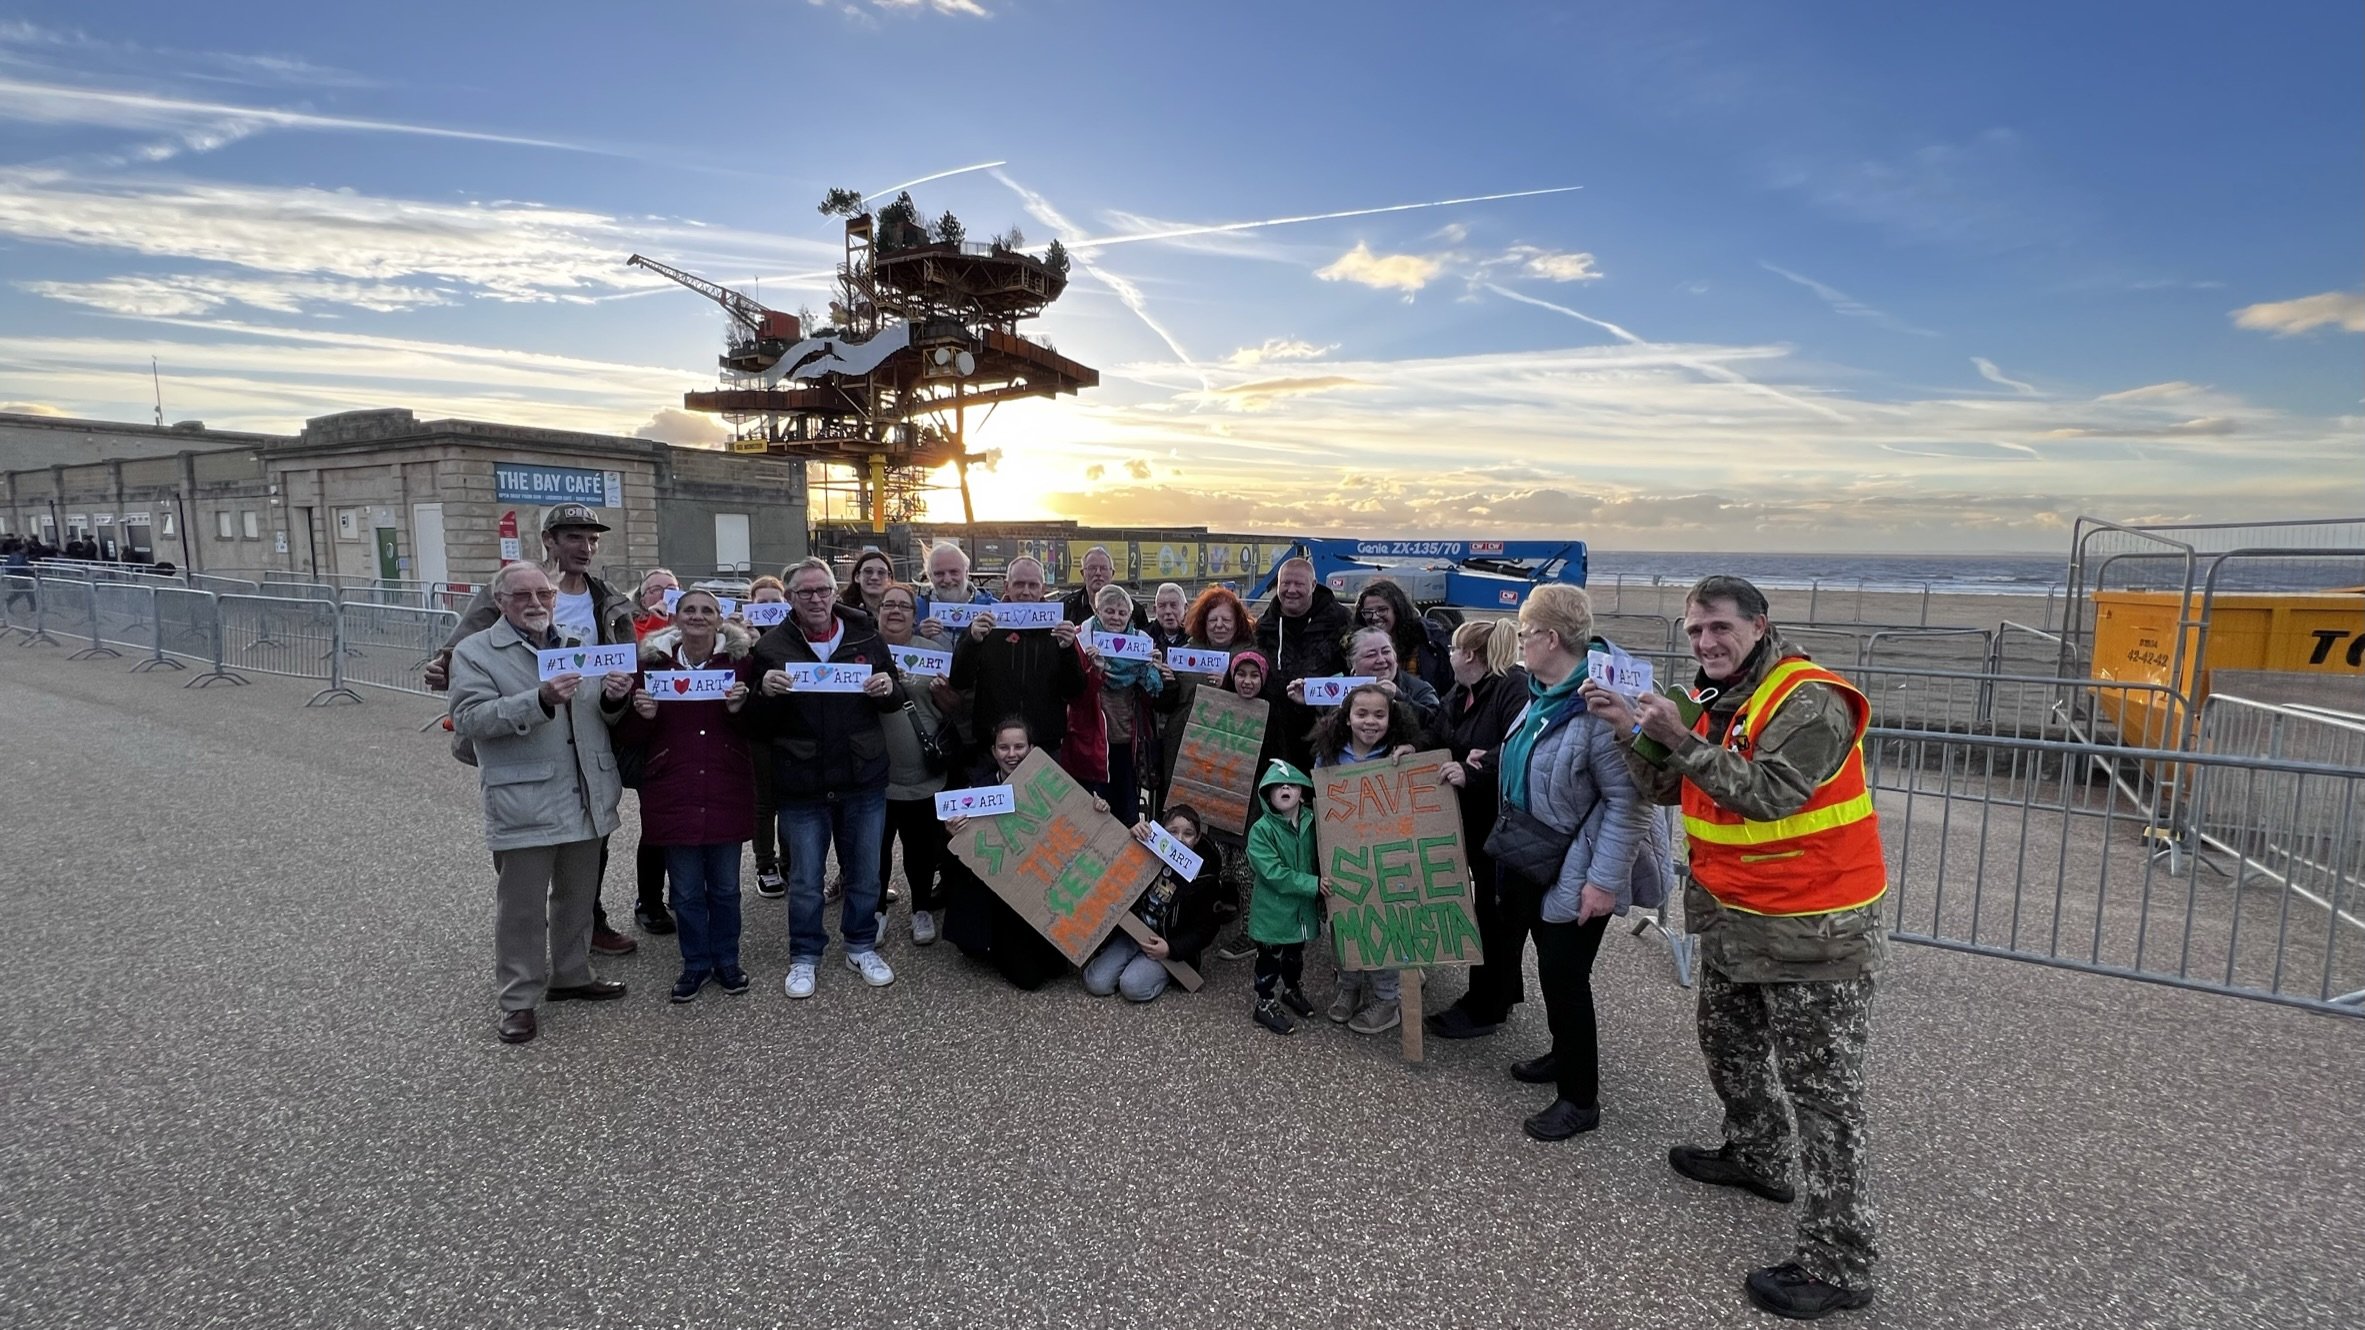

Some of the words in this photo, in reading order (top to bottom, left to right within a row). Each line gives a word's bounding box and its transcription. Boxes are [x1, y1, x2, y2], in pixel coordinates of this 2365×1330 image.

[497, 471, 528, 490] THE
[533, 473, 561, 492] BAY
[565, 472, 602, 494] CAFÉ
[1357, 542, 1389, 554] Genie
[1391, 542, 1461, 555] ZX-135/70
[1031, 611, 1055, 622] ART
[1098, 638, 1110, 649] #I
[1126, 641, 1147, 653] ART
[546, 657, 566, 671] #I
[593, 653, 625, 666] ART
[918, 656, 943, 669] ART
[1171, 655, 1184, 664] #I
[1200, 657, 1221, 667] ART
[652, 680, 669, 693] #I
[695, 679, 725, 692] ART
[793, 671, 809, 683] #I
[833, 672, 861, 683] ART
[1325, 763, 1441, 822] SAVE
[943, 799, 957, 812] #I
[979, 794, 1004, 807] ART
[975, 764, 1073, 877] SAVE
[1016, 815, 1088, 885] THE
[1169, 848, 1193, 870] ART
[1331, 832, 1465, 905] SEE
[1047, 852, 1106, 917] SEE
[1331, 902, 1483, 966] MONSTA
